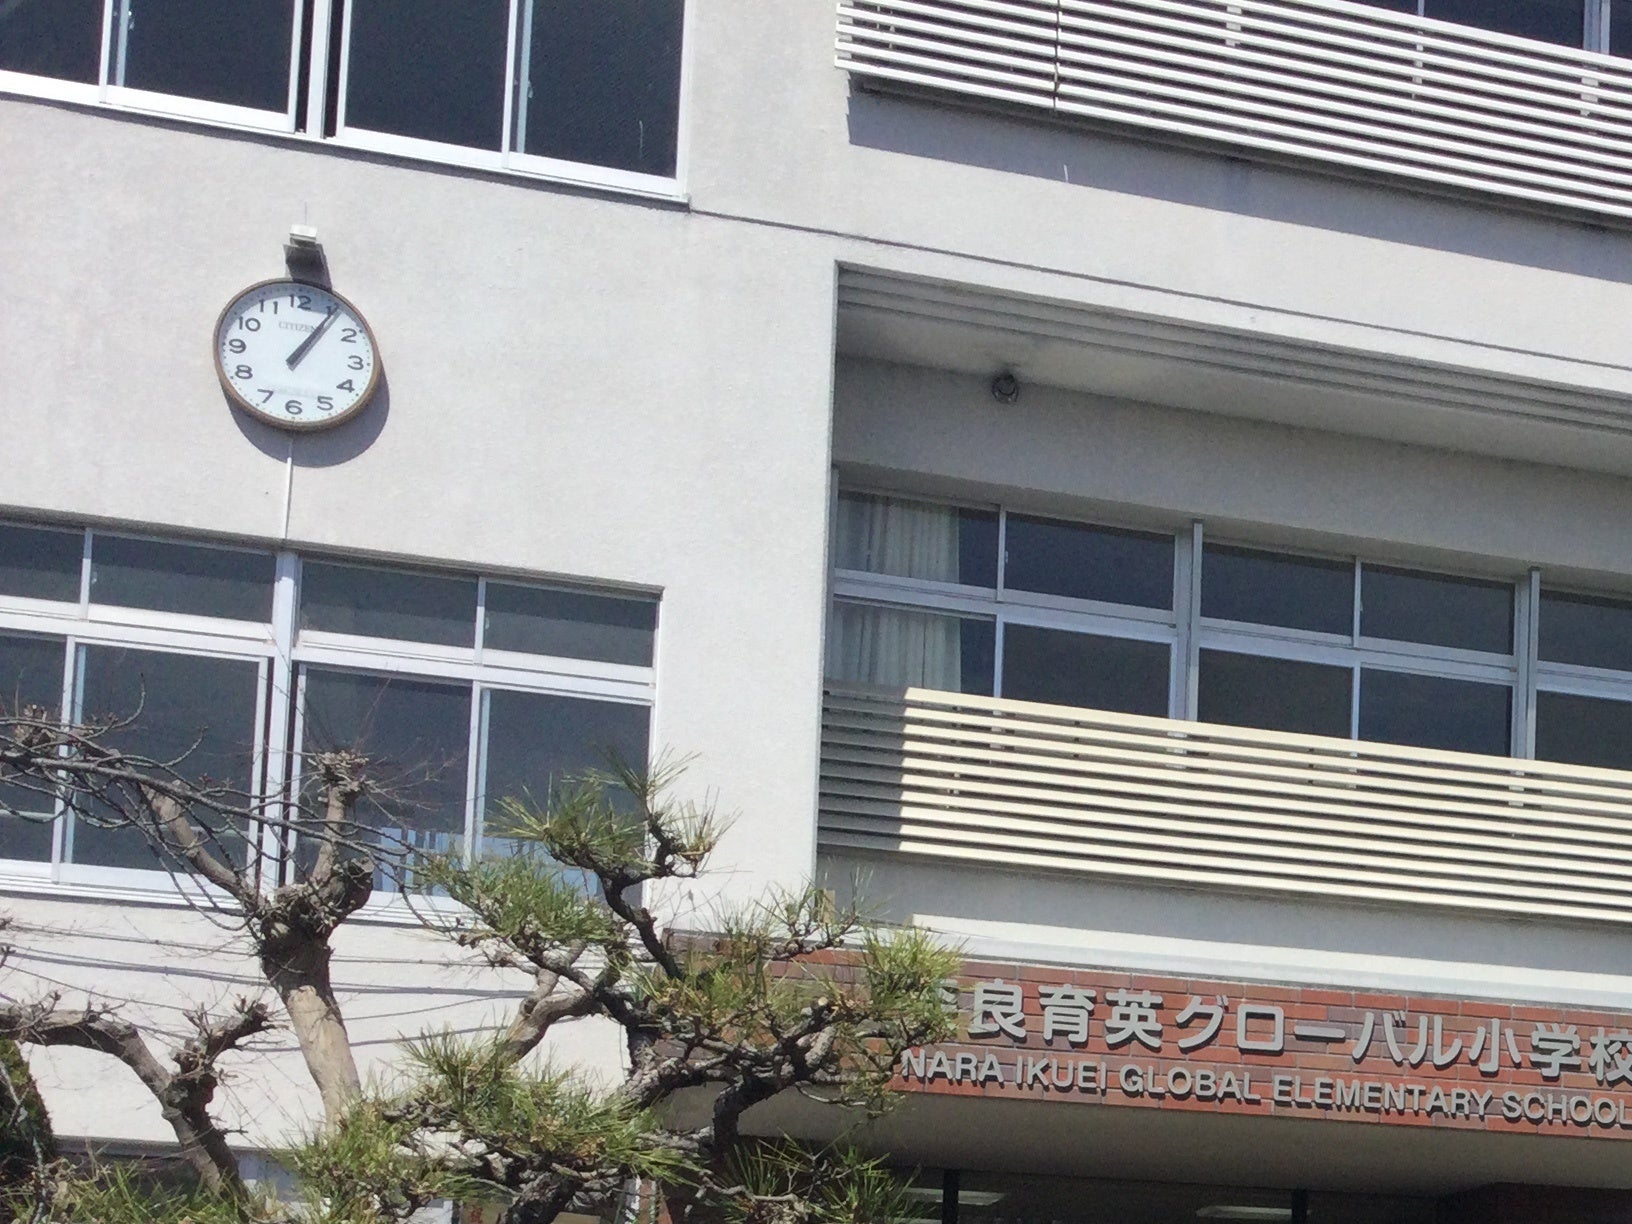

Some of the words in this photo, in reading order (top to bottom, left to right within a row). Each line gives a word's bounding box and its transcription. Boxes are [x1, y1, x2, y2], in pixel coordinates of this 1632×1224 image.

[258, 299, 279, 315] 11
[289, 293, 312, 311] 12
[237, 316, 262, 332] 10
[341, 328, 357, 344] 2
[228, 338, 247, 354] 9
[347, 354, 364, 371] 3
[235, 364, 254, 380] 8
[336, 379, 355, 393] 4
[257, 389, 273, 404] 7
[316, 396, 334, 411] 5
[285, 399, 303, 415] 6
[901, 1048, 1005, 1085] NARA
[1015, 1056, 1109, 1094] IKUEI
[1119, 1064, 1263, 1104] GLOBAL
[1272, 1075, 1493, 1121] ELEMENTARY
